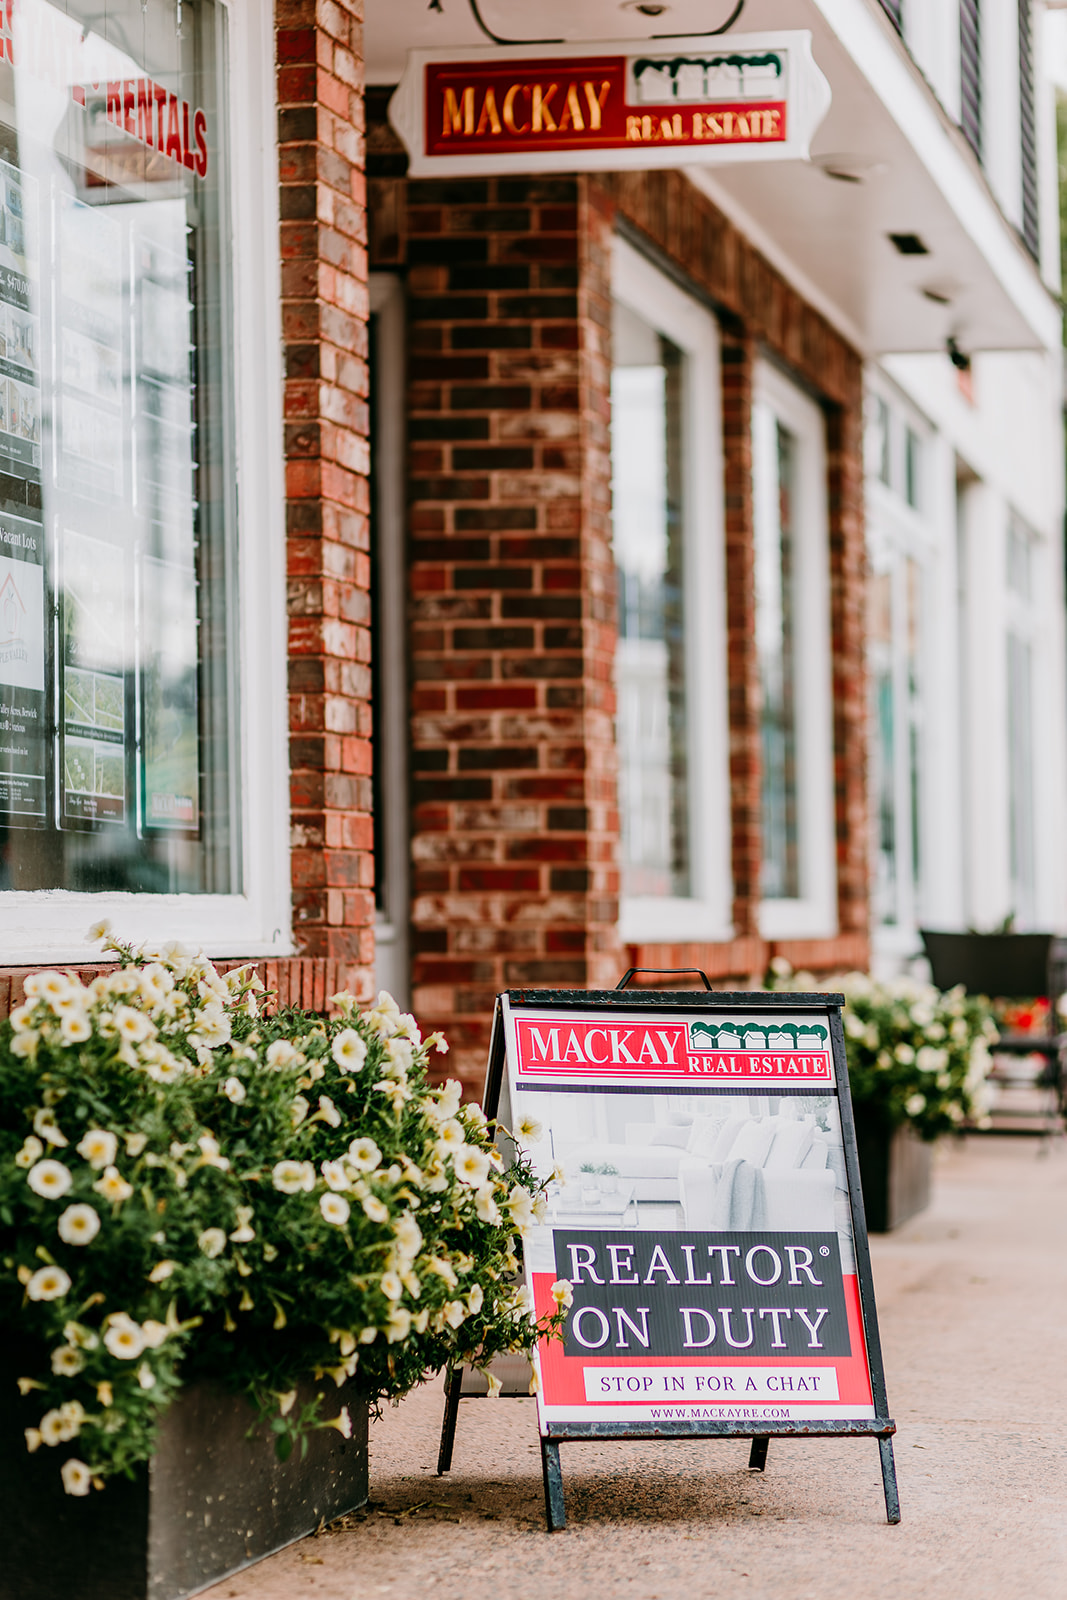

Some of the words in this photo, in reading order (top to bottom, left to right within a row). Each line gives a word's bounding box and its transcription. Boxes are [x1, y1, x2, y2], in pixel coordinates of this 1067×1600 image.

[441, 81, 611, 138] MACKAY
[625, 112, 689, 141] REAL
[692, 109, 781, 139] ESTATE
[105, 77, 208, 178] RENTALS
[0, 526, 21, 547] Vacant
[22, 533, 37, 551] Lots
[527, 1026, 681, 1065] MACKAY
[687, 1056, 743, 1074] REAL
[749, 1056, 826, 1075] ESTATE
[572, 1306, 650, 1349] ON
[679, 1307, 829, 1349] DUTY
[600, 1376, 653, 1392] STOP
[664, 1376, 685, 1392] IN
[696, 1376, 737, 1392] FOR
[745, 1376, 759, 1392] A
[766, 1376, 822, 1392] CHAT
[650, 1407, 791, 1419] WWW.MACKAYRE.COM
